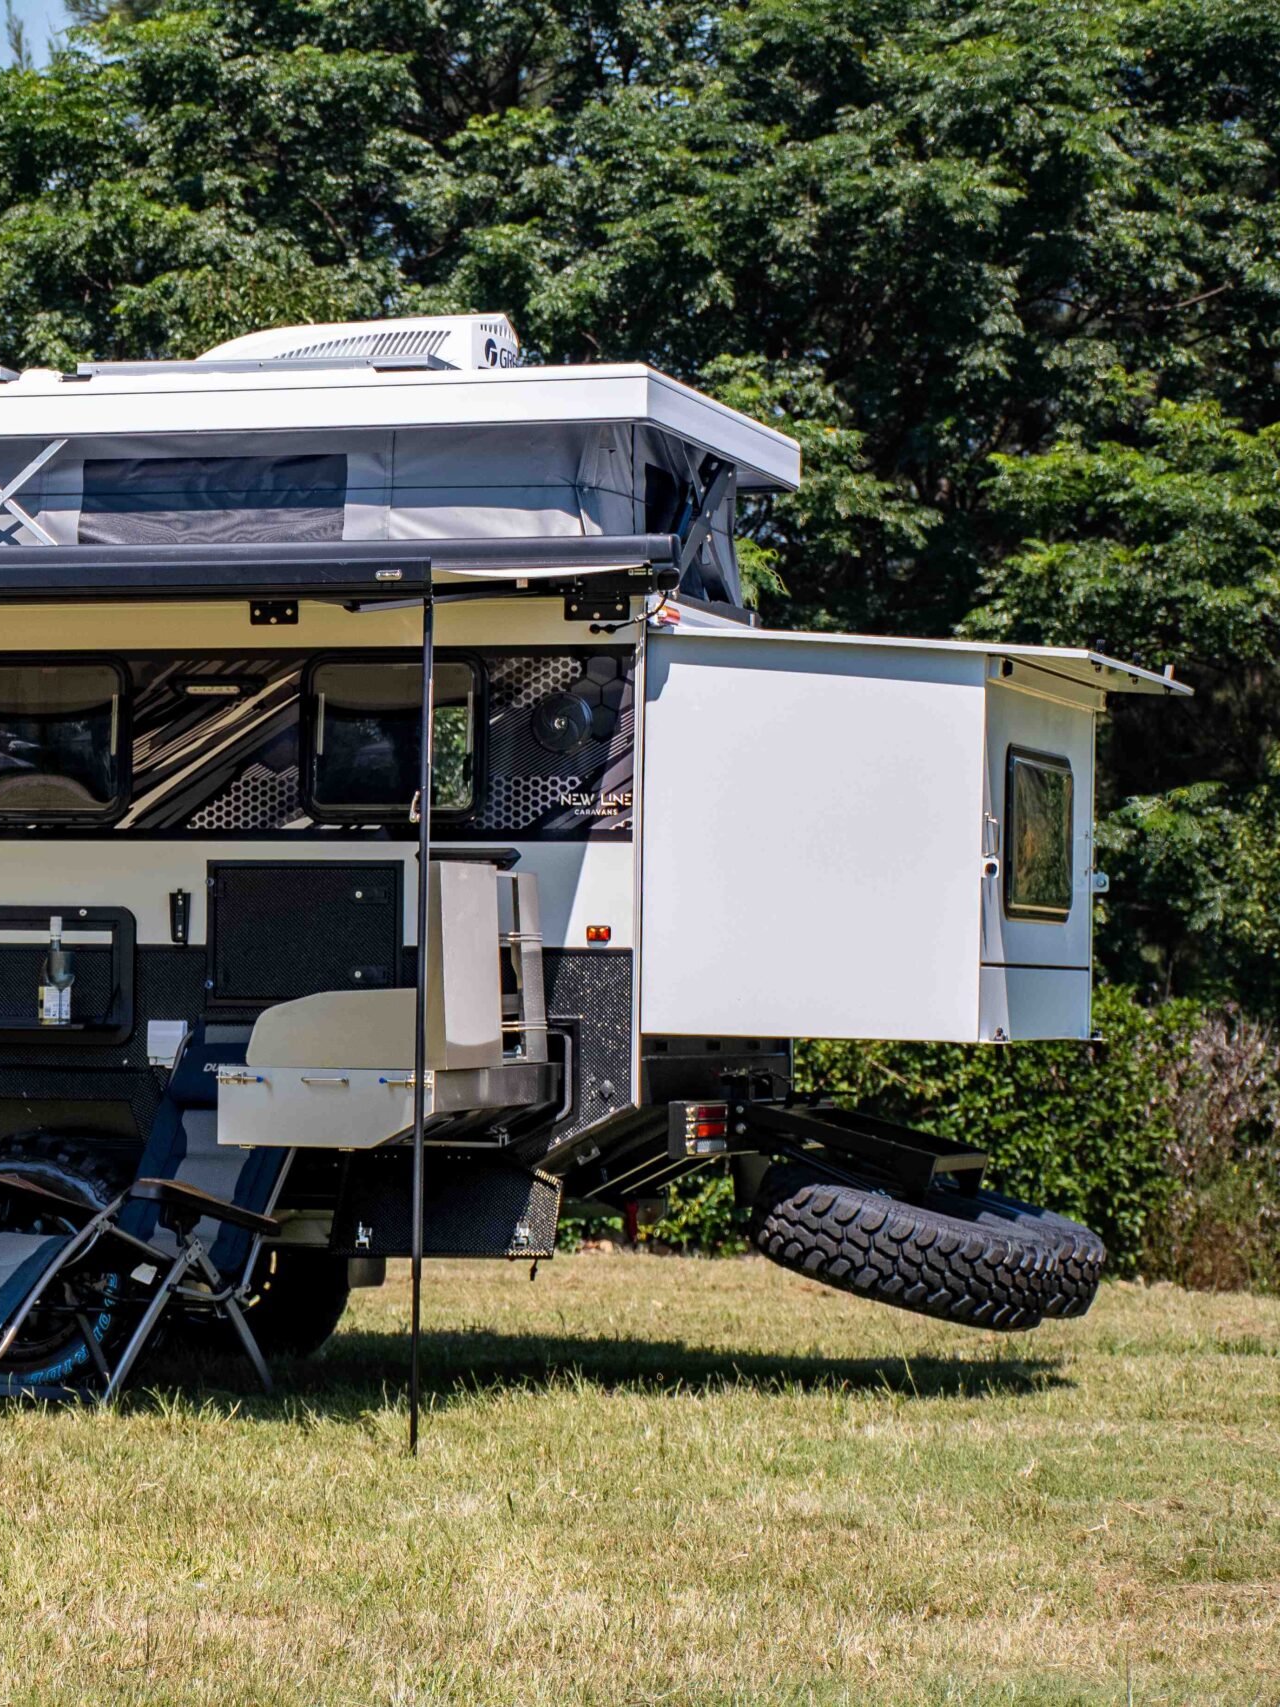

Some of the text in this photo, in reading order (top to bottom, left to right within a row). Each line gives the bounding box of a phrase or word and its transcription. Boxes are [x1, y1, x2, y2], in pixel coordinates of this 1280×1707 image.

[560, 793, 632, 806] NEW LINE
[574, 808, 617, 816] CARAVANS
